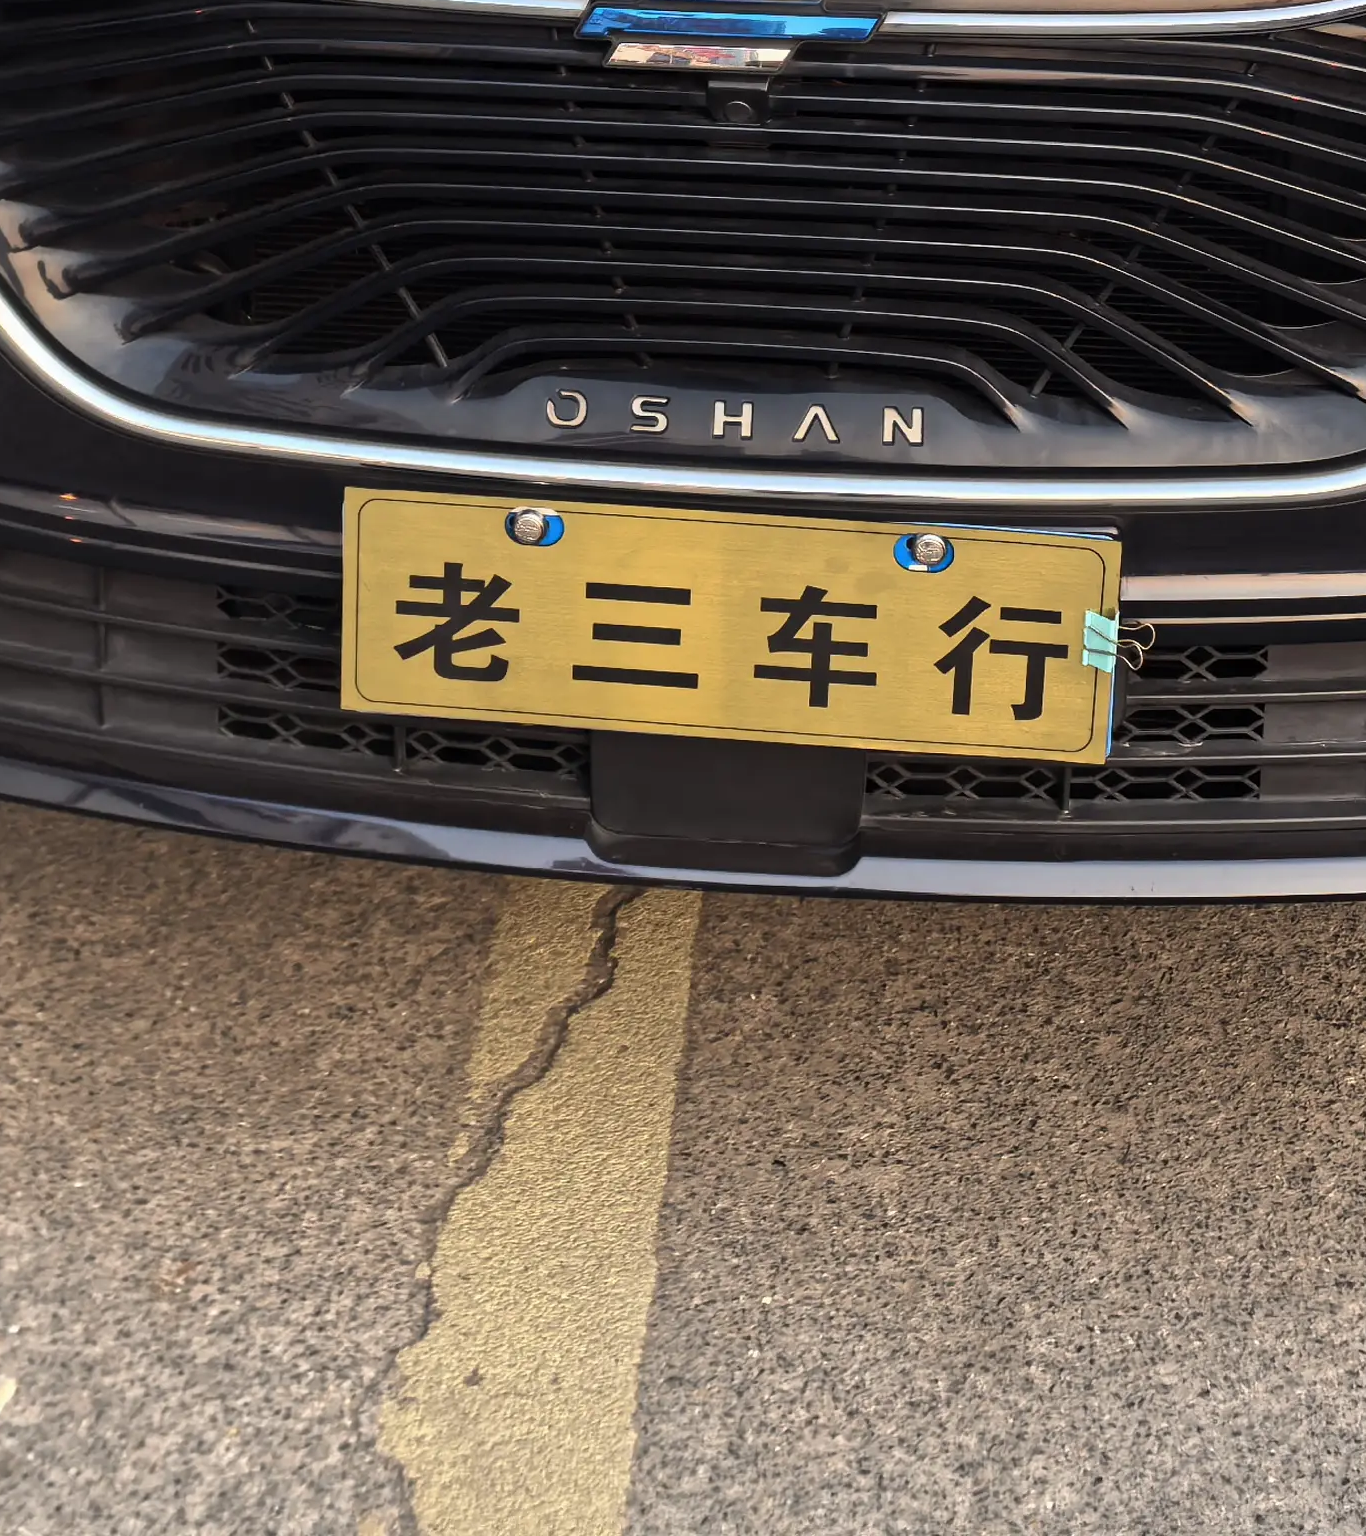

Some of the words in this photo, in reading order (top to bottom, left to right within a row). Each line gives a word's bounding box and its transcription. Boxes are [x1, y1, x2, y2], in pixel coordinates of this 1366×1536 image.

[545, 388, 926, 446] OSHAN
[394, 562, 1069, 721] 老三车行
